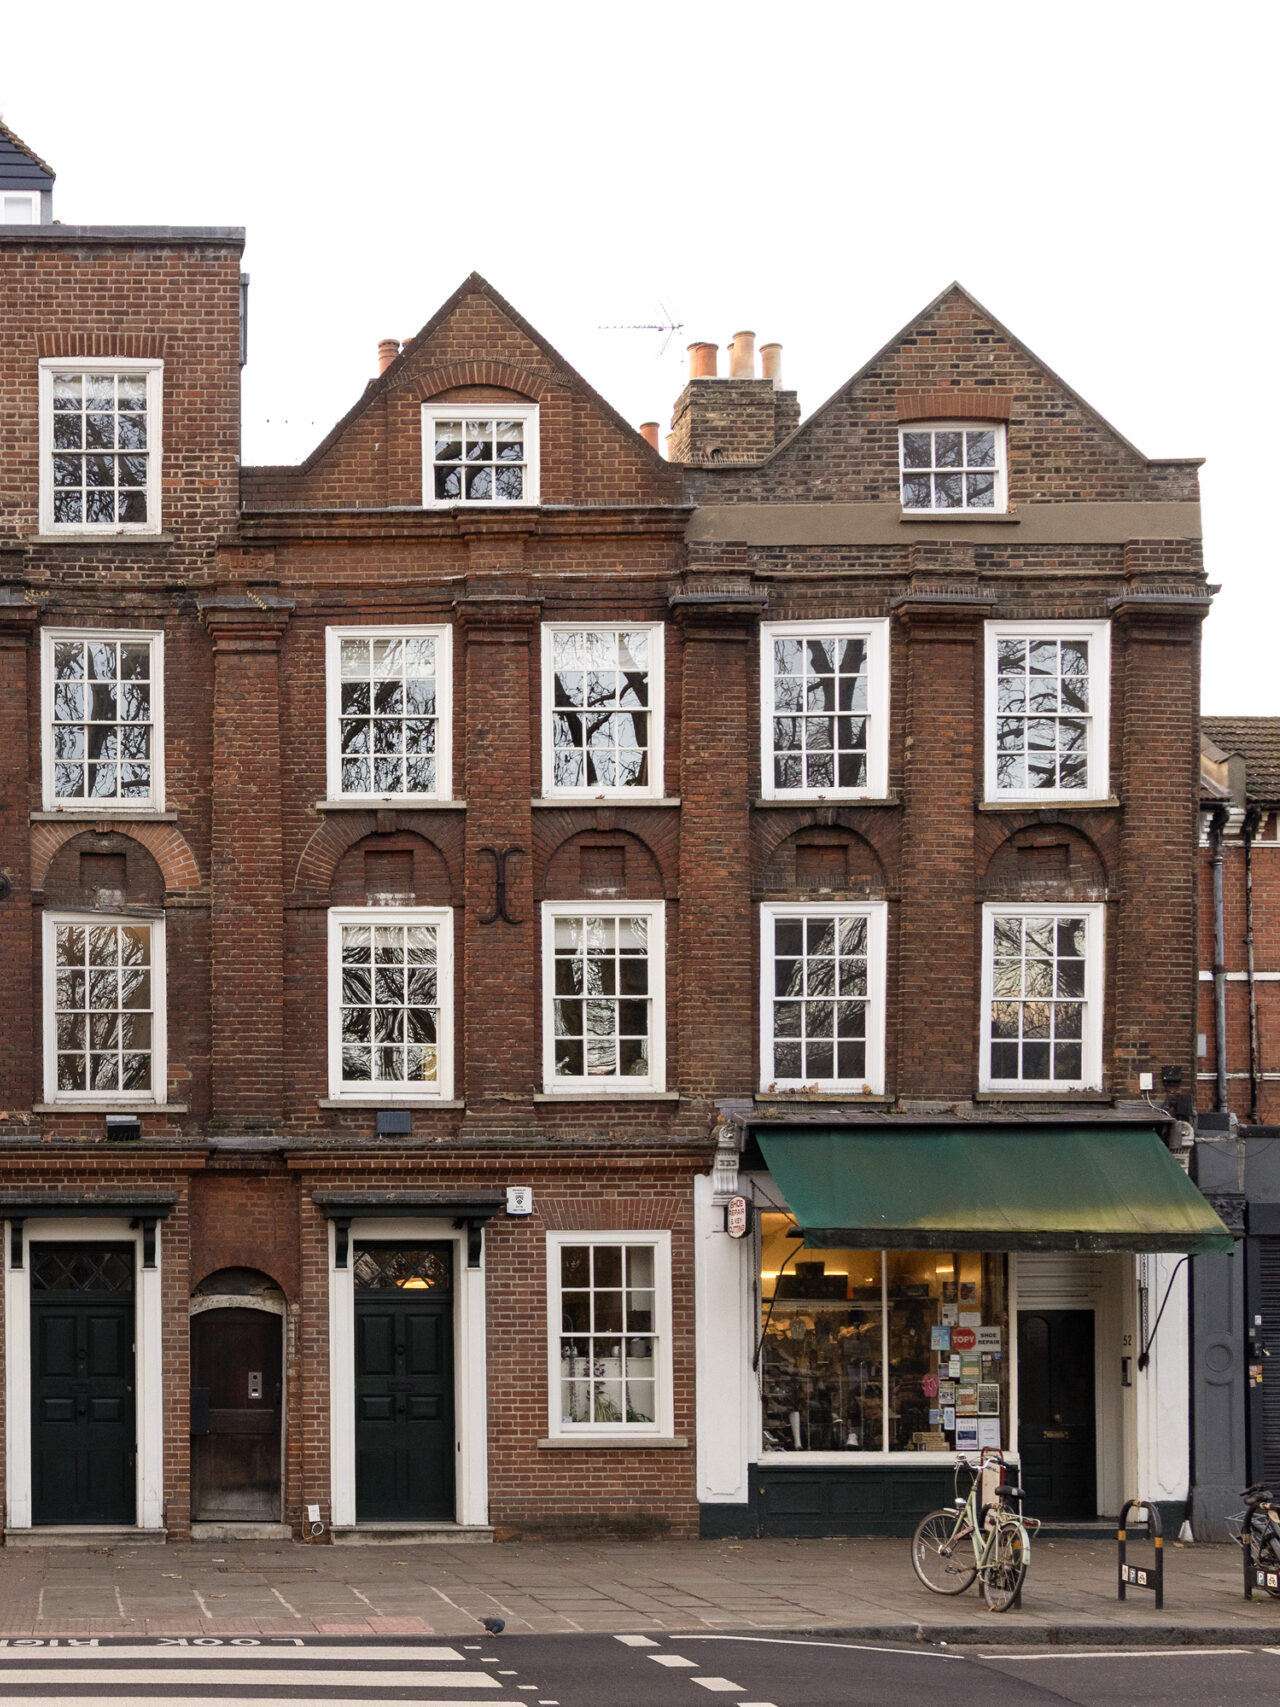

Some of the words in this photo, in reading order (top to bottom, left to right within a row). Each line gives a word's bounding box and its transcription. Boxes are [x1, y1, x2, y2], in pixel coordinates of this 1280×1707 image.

[730, 1199, 744, 1208] SHOE
[729, 1208, 745, 1216] REPAIR
[952, 1336, 975, 1344] TOPY
[1123, 1334, 1132, 1346] 52
[158, 1638, 304, 1647] LOOK
